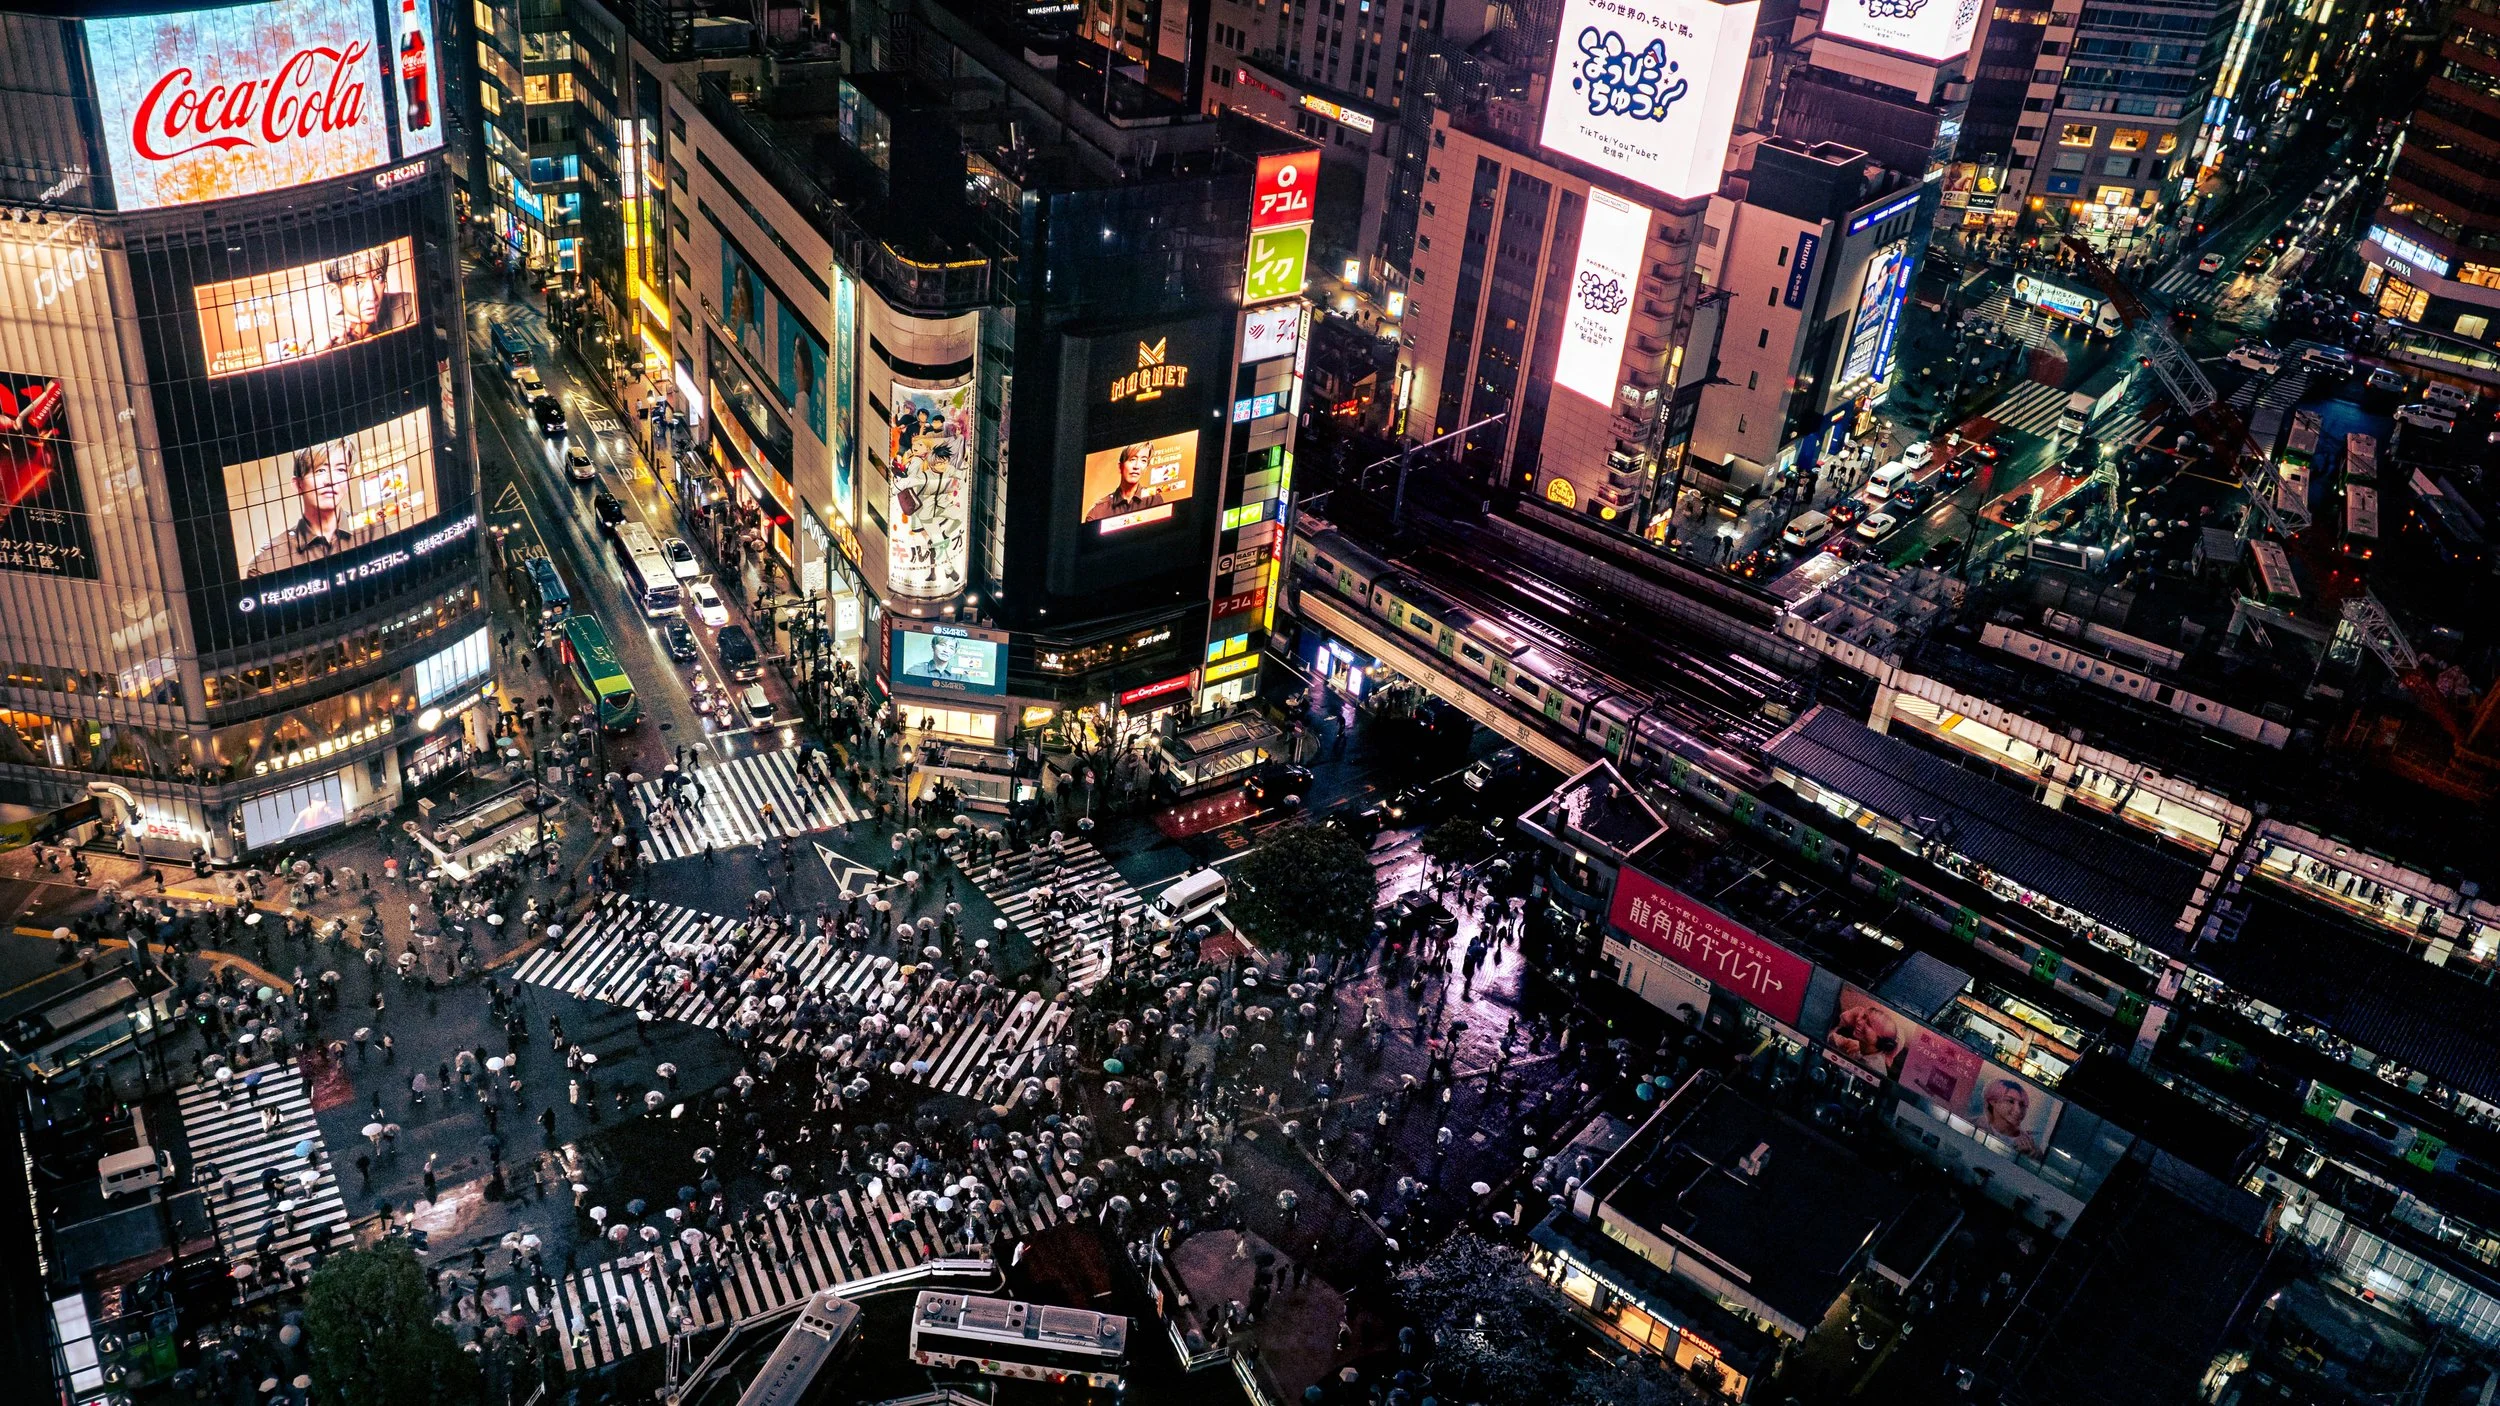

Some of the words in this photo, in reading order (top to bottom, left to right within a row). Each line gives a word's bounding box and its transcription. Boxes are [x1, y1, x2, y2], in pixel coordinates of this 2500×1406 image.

[1027, 5, 1060, 15] MIYASHITA
[1062, 3, 1079, 11] PARK
[132, 39, 372, 161] Coca-Cola
[375, 161, 426, 187] QFRONT
[1260, 190, 1308, 216] アコム
[1800, 238, 1813, 270] MIZUHO
[2385, 256, 2412, 277] LOWYA
[1574, 322, 1613, 345] YouTubeで
[1582, 316, 1608, 333] TikTok
[216, 345, 258, 360] PREMIUM
[212, 355, 263, 373] Ghana
[1111, 365, 1188, 401] MAGNET
[1150, 453, 1182, 465] Ghana
[1154, 446, 1181, 456] PREMIUM
[1552, 484, 1572, 498] Public
[1218, 596, 1251, 614] アコム
[942, 628, 968, 637] STARTS
[1041, 662, 1064, 670] COFFEE
[940, 681, 966, 691] STARTS
[1424, 672, 1436, 683] JR
[443, 694, 480, 718] TSUTAYA
[254, 718, 393, 775] STARBUCKS
[1650, 893, 1772, 963] 水なしで飲む、のど直接うるおう
[1629, 896, 1783, 994] 龍角散ダイレクト
[929, 1296, 957, 1307] 1903
[1569, 1257, 1592, 1276] SHIBU
[1591, 1270, 1618, 1293] HACHI
[1617, 1287, 1637, 1305] BOX
[1680, 1326, 1722, 1359] G-SHOCK
